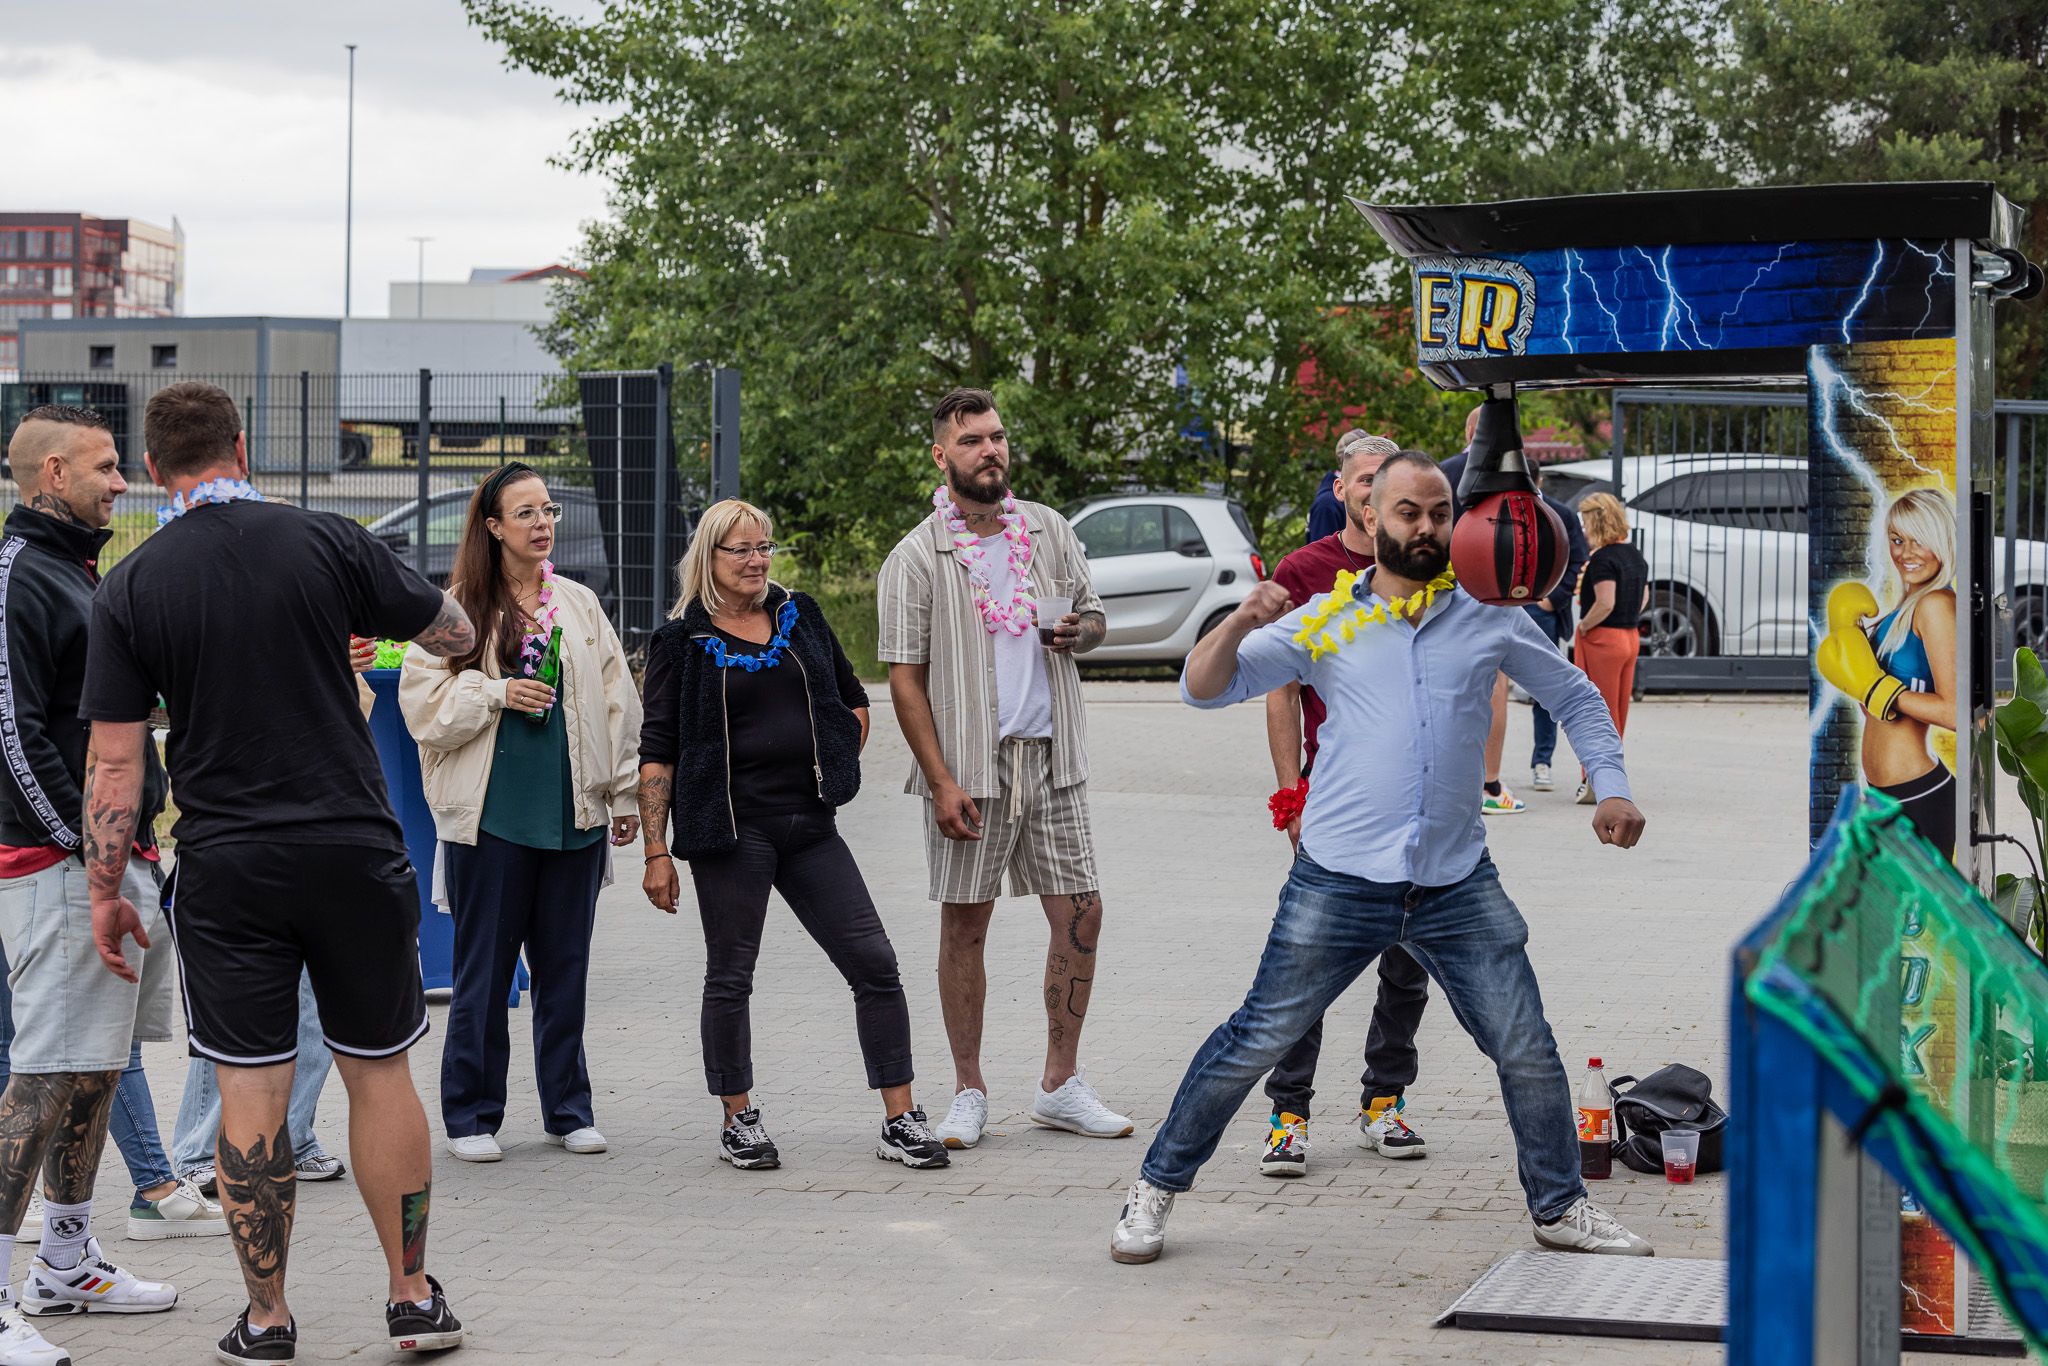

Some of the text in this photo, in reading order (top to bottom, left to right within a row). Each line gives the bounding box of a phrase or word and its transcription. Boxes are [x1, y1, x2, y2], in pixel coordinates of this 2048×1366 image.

[1419, 272, 1522, 355] ER
[5, 735, 24, 775] LABEL 23
[26, 788, 52, 821] LABEL 23
